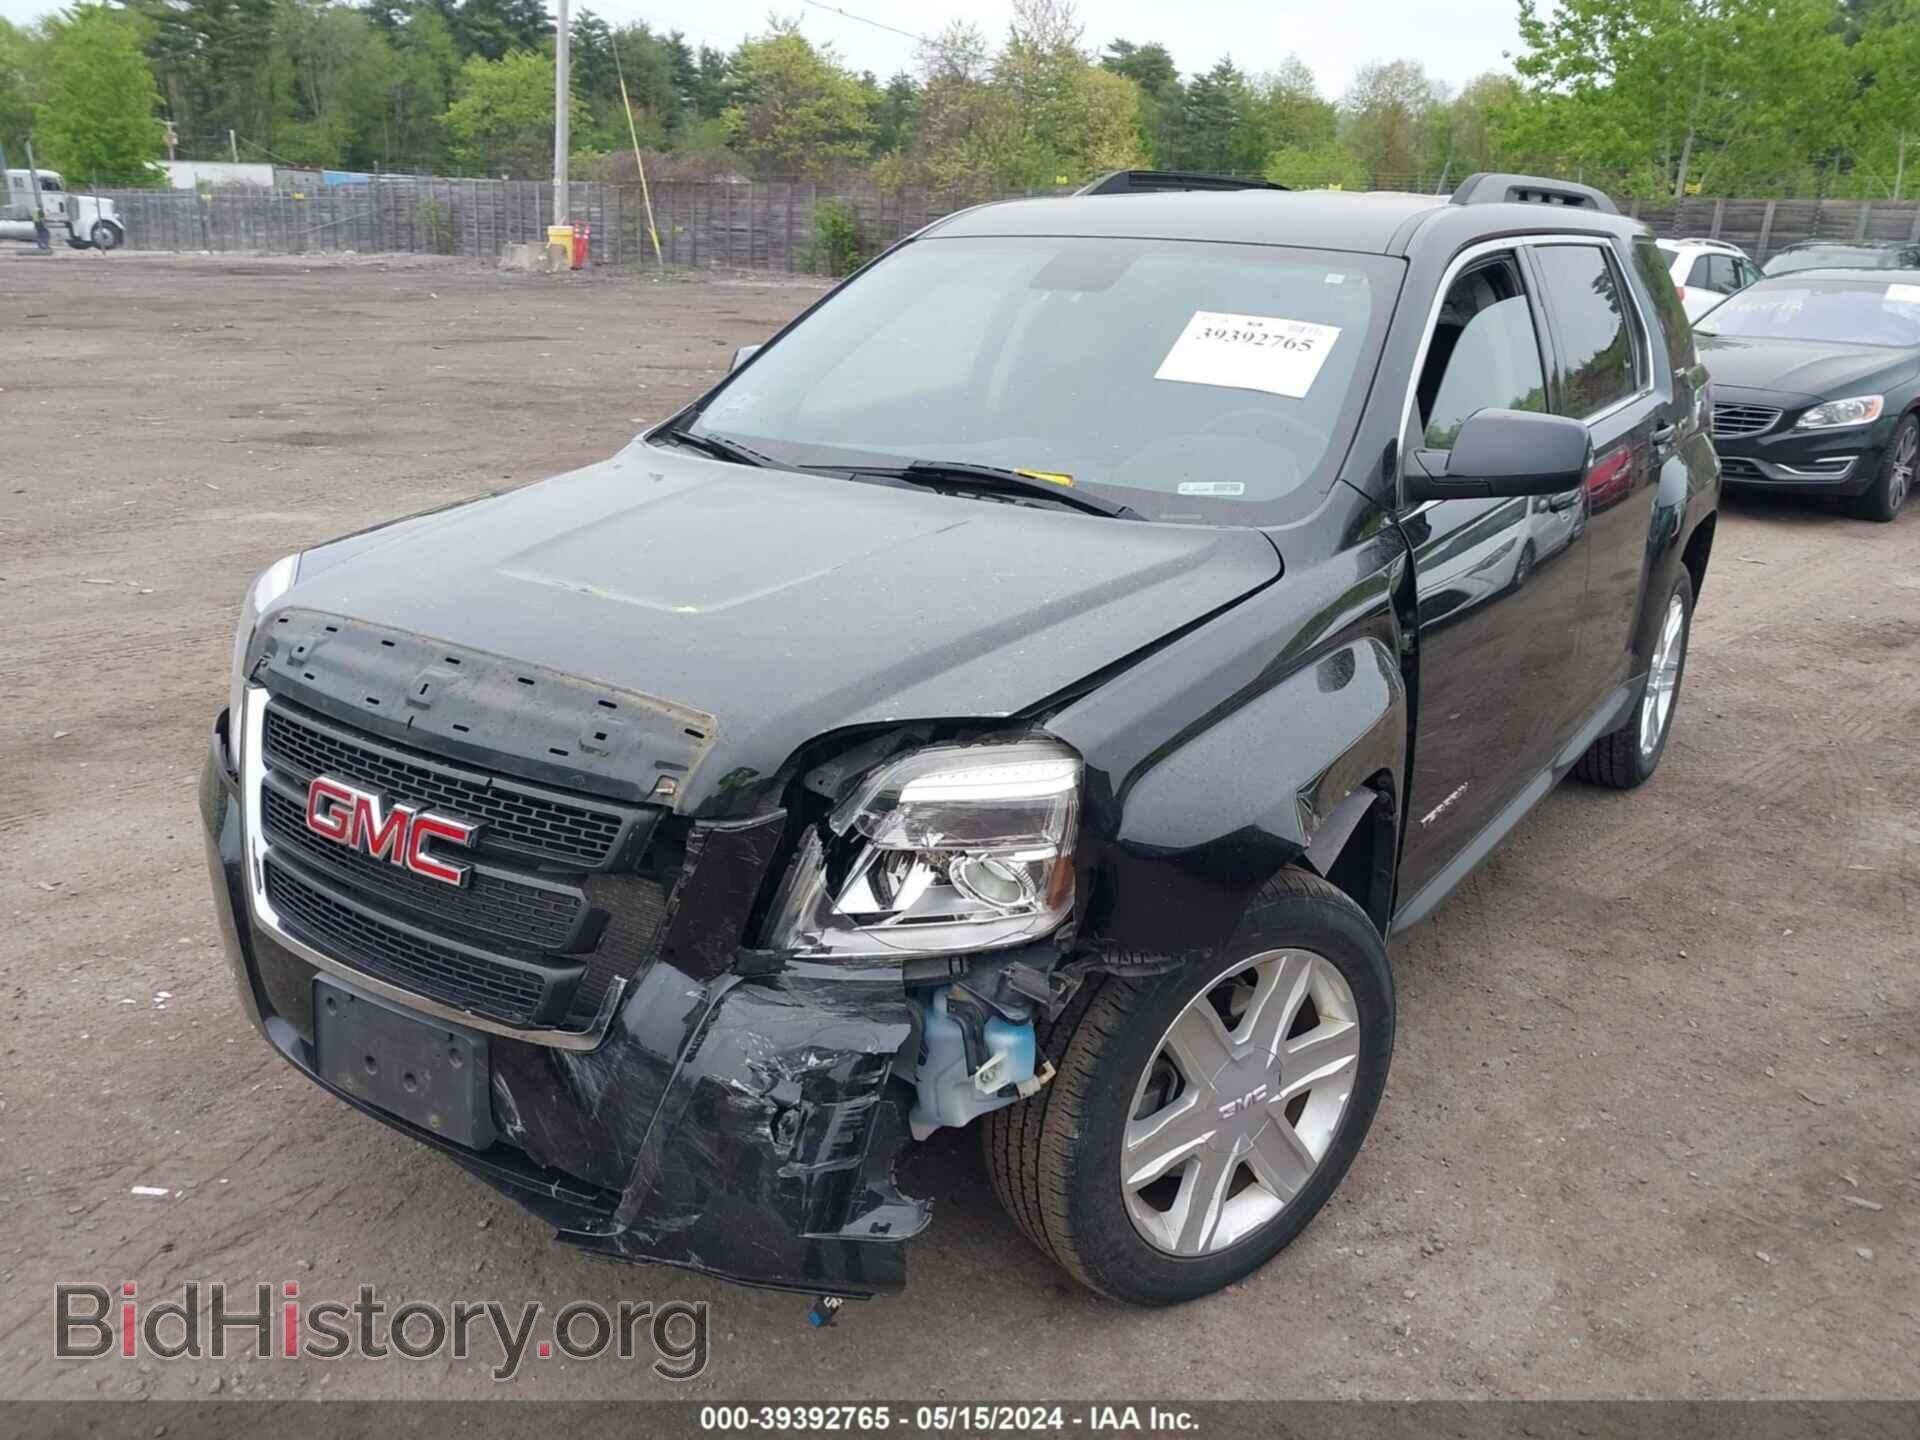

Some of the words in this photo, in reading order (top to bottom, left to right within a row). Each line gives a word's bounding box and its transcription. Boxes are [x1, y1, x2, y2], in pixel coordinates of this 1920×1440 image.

[1196, 326, 1315, 352] 39392765
[306, 775, 475, 887] GMC
[1219, 1083, 1267, 1119] GMC
